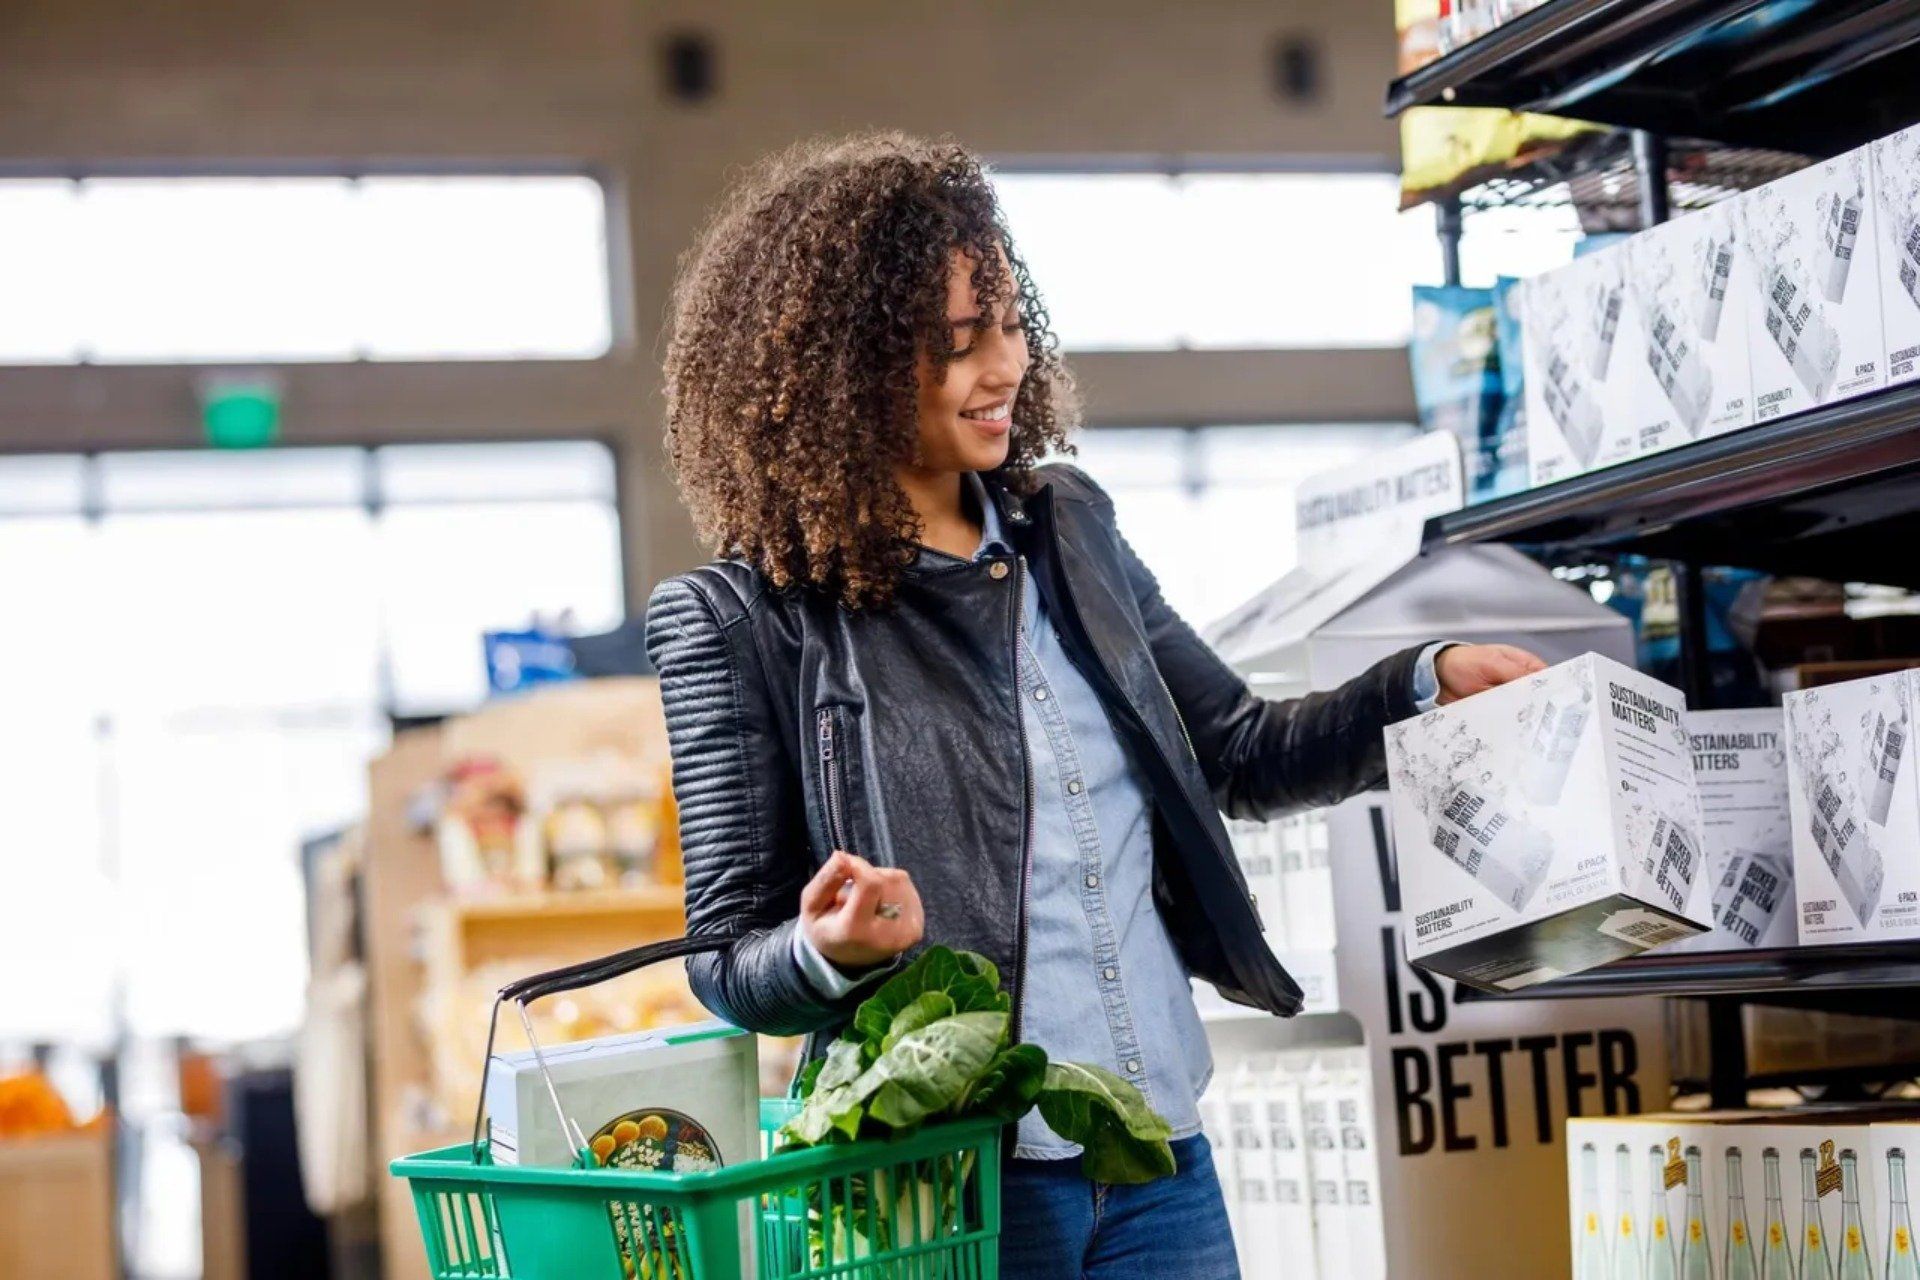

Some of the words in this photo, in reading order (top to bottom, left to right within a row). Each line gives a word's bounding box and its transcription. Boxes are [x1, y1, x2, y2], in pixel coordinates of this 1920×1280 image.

[1609, 681, 1680, 727] SUSTAINABILITY
[1611, 701, 1657, 734] MATTERS
[1444, 790, 1471, 820] BOXED
[1454, 796, 1484, 829] WATER
[1466, 823, 1481, 839] IS
[1477, 812, 1509, 847] BETTER
[1584, 853, 1608, 869] PACK
[1668, 829, 1692, 867] BOXED
[1665, 844, 1692, 886] WATER
[1746, 861, 1778, 893] BOXED
[1656, 869, 1684, 915] BETTER
[1729, 893, 1744, 912] IS
[1739, 878, 1775, 914] WATER
[1415, 898, 1475, 927] SUSTAINABILITY
[1416, 917, 1453, 939] MATTERS
[1722, 910, 1760, 947] BETTER
[1391, 1029, 1641, 1157] BETTER
